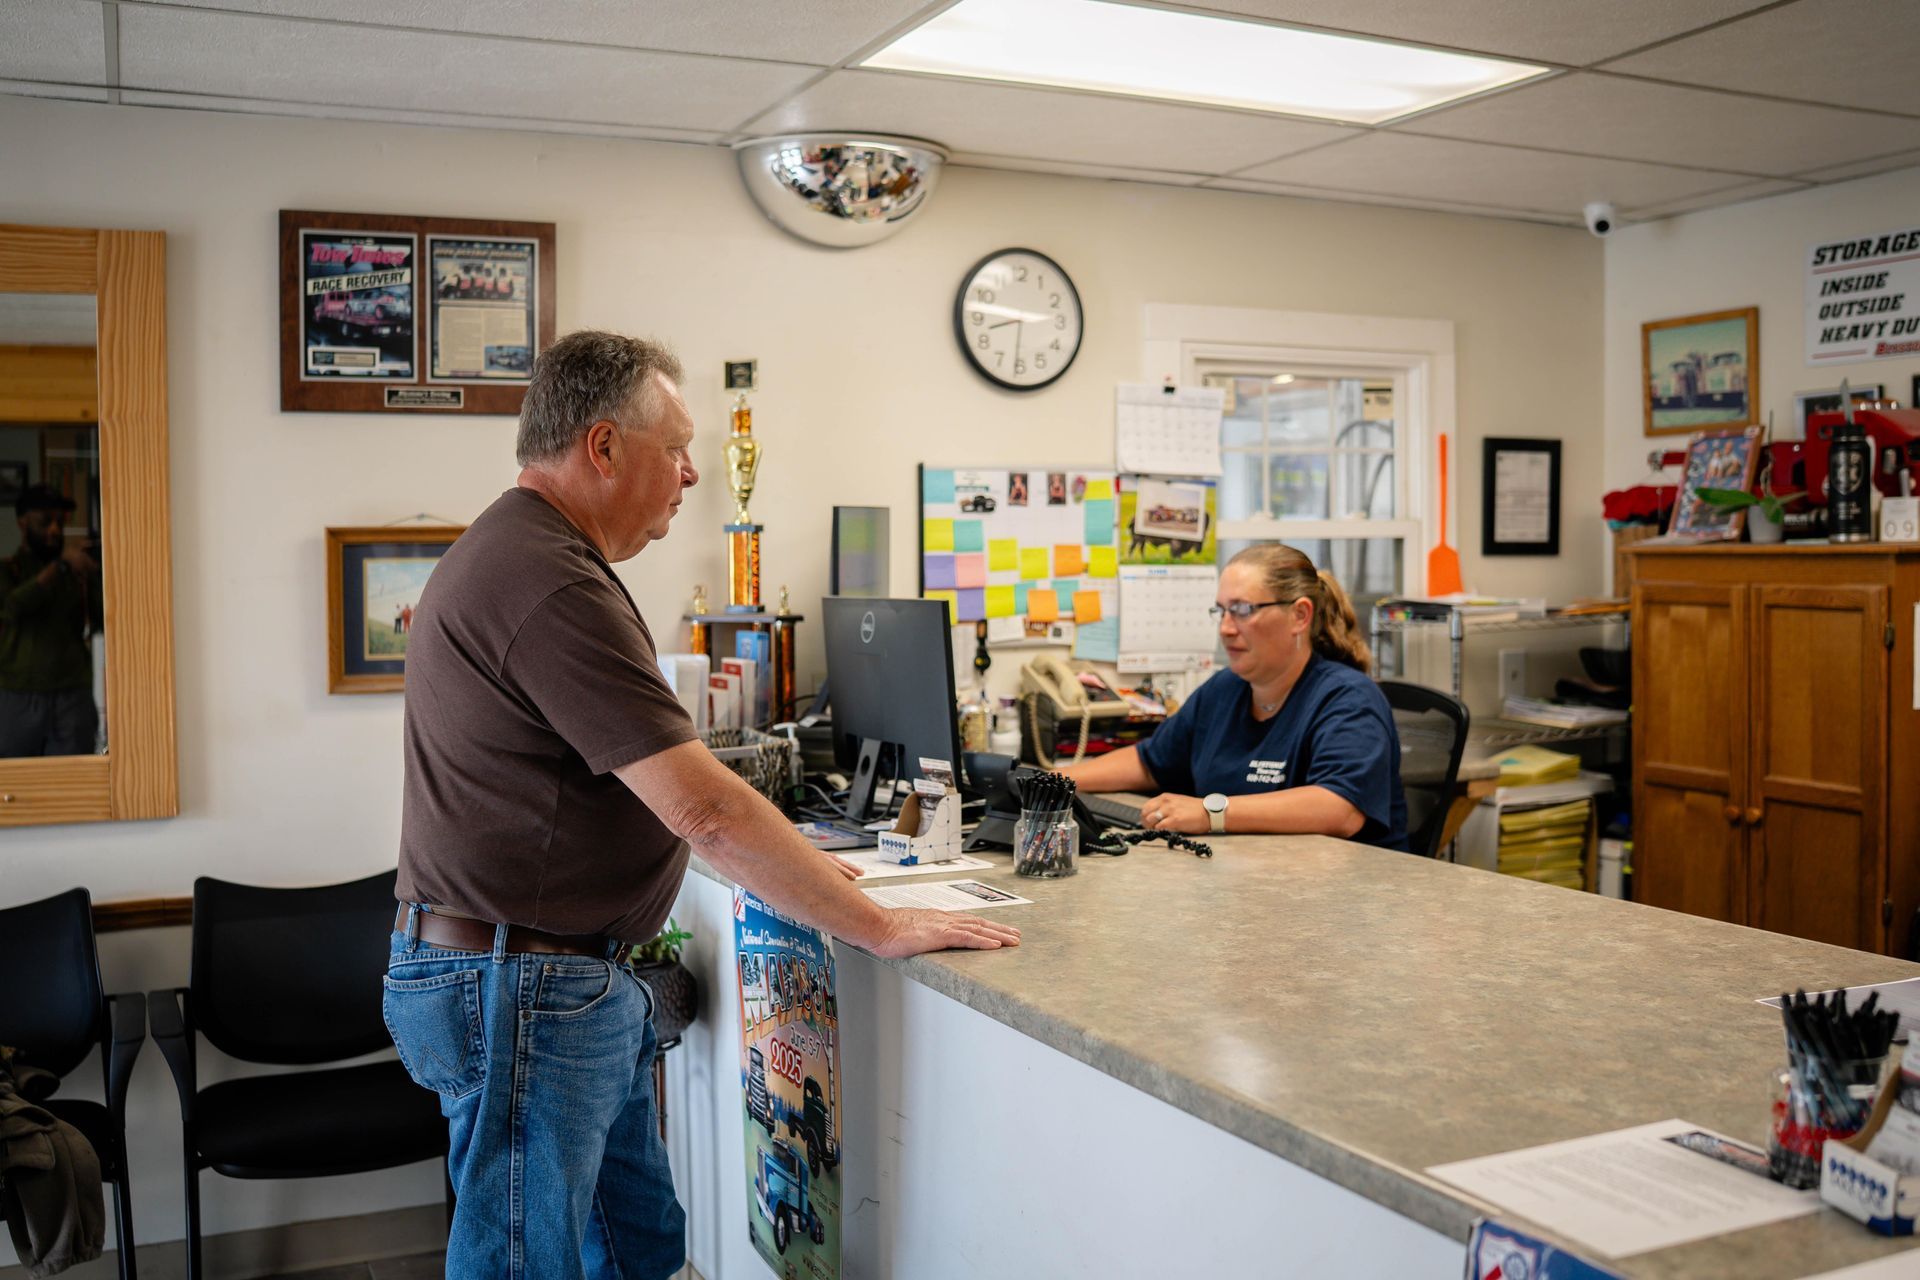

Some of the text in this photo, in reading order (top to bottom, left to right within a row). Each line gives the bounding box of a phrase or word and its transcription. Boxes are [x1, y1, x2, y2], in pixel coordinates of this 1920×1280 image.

[312, 242, 348, 263] Tow
[1812, 230, 1920, 266] STORAGE
[312, 272, 405, 292] RACE RECOVERY
[1037, 275, 1043, 290] 1
[1820, 271, 1889, 296] INSIDE
[976, 288, 995, 304] 10
[1050, 294, 1061, 308] 2
[1818, 294, 1905, 321] OUTSIDE
[971, 311, 984, 326] 9
[1055, 314, 1065, 330] 3
[1820, 321, 1888, 344] HEAVY
[978, 334, 990, 350] 8
[1050, 339, 1060, 351] 4
[994, 352, 1004, 367] 7
[1014, 359, 1026, 375] 6
[1034, 353, 1047, 369] 5
[740, 925, 764, 948] National
[764, 930, 789, 948] Convention
[738, 950, 839, 1033] MADISON
[790, 1025, 820, 1059] June 5-7
[771, 1039, 803, 1087] 2025
